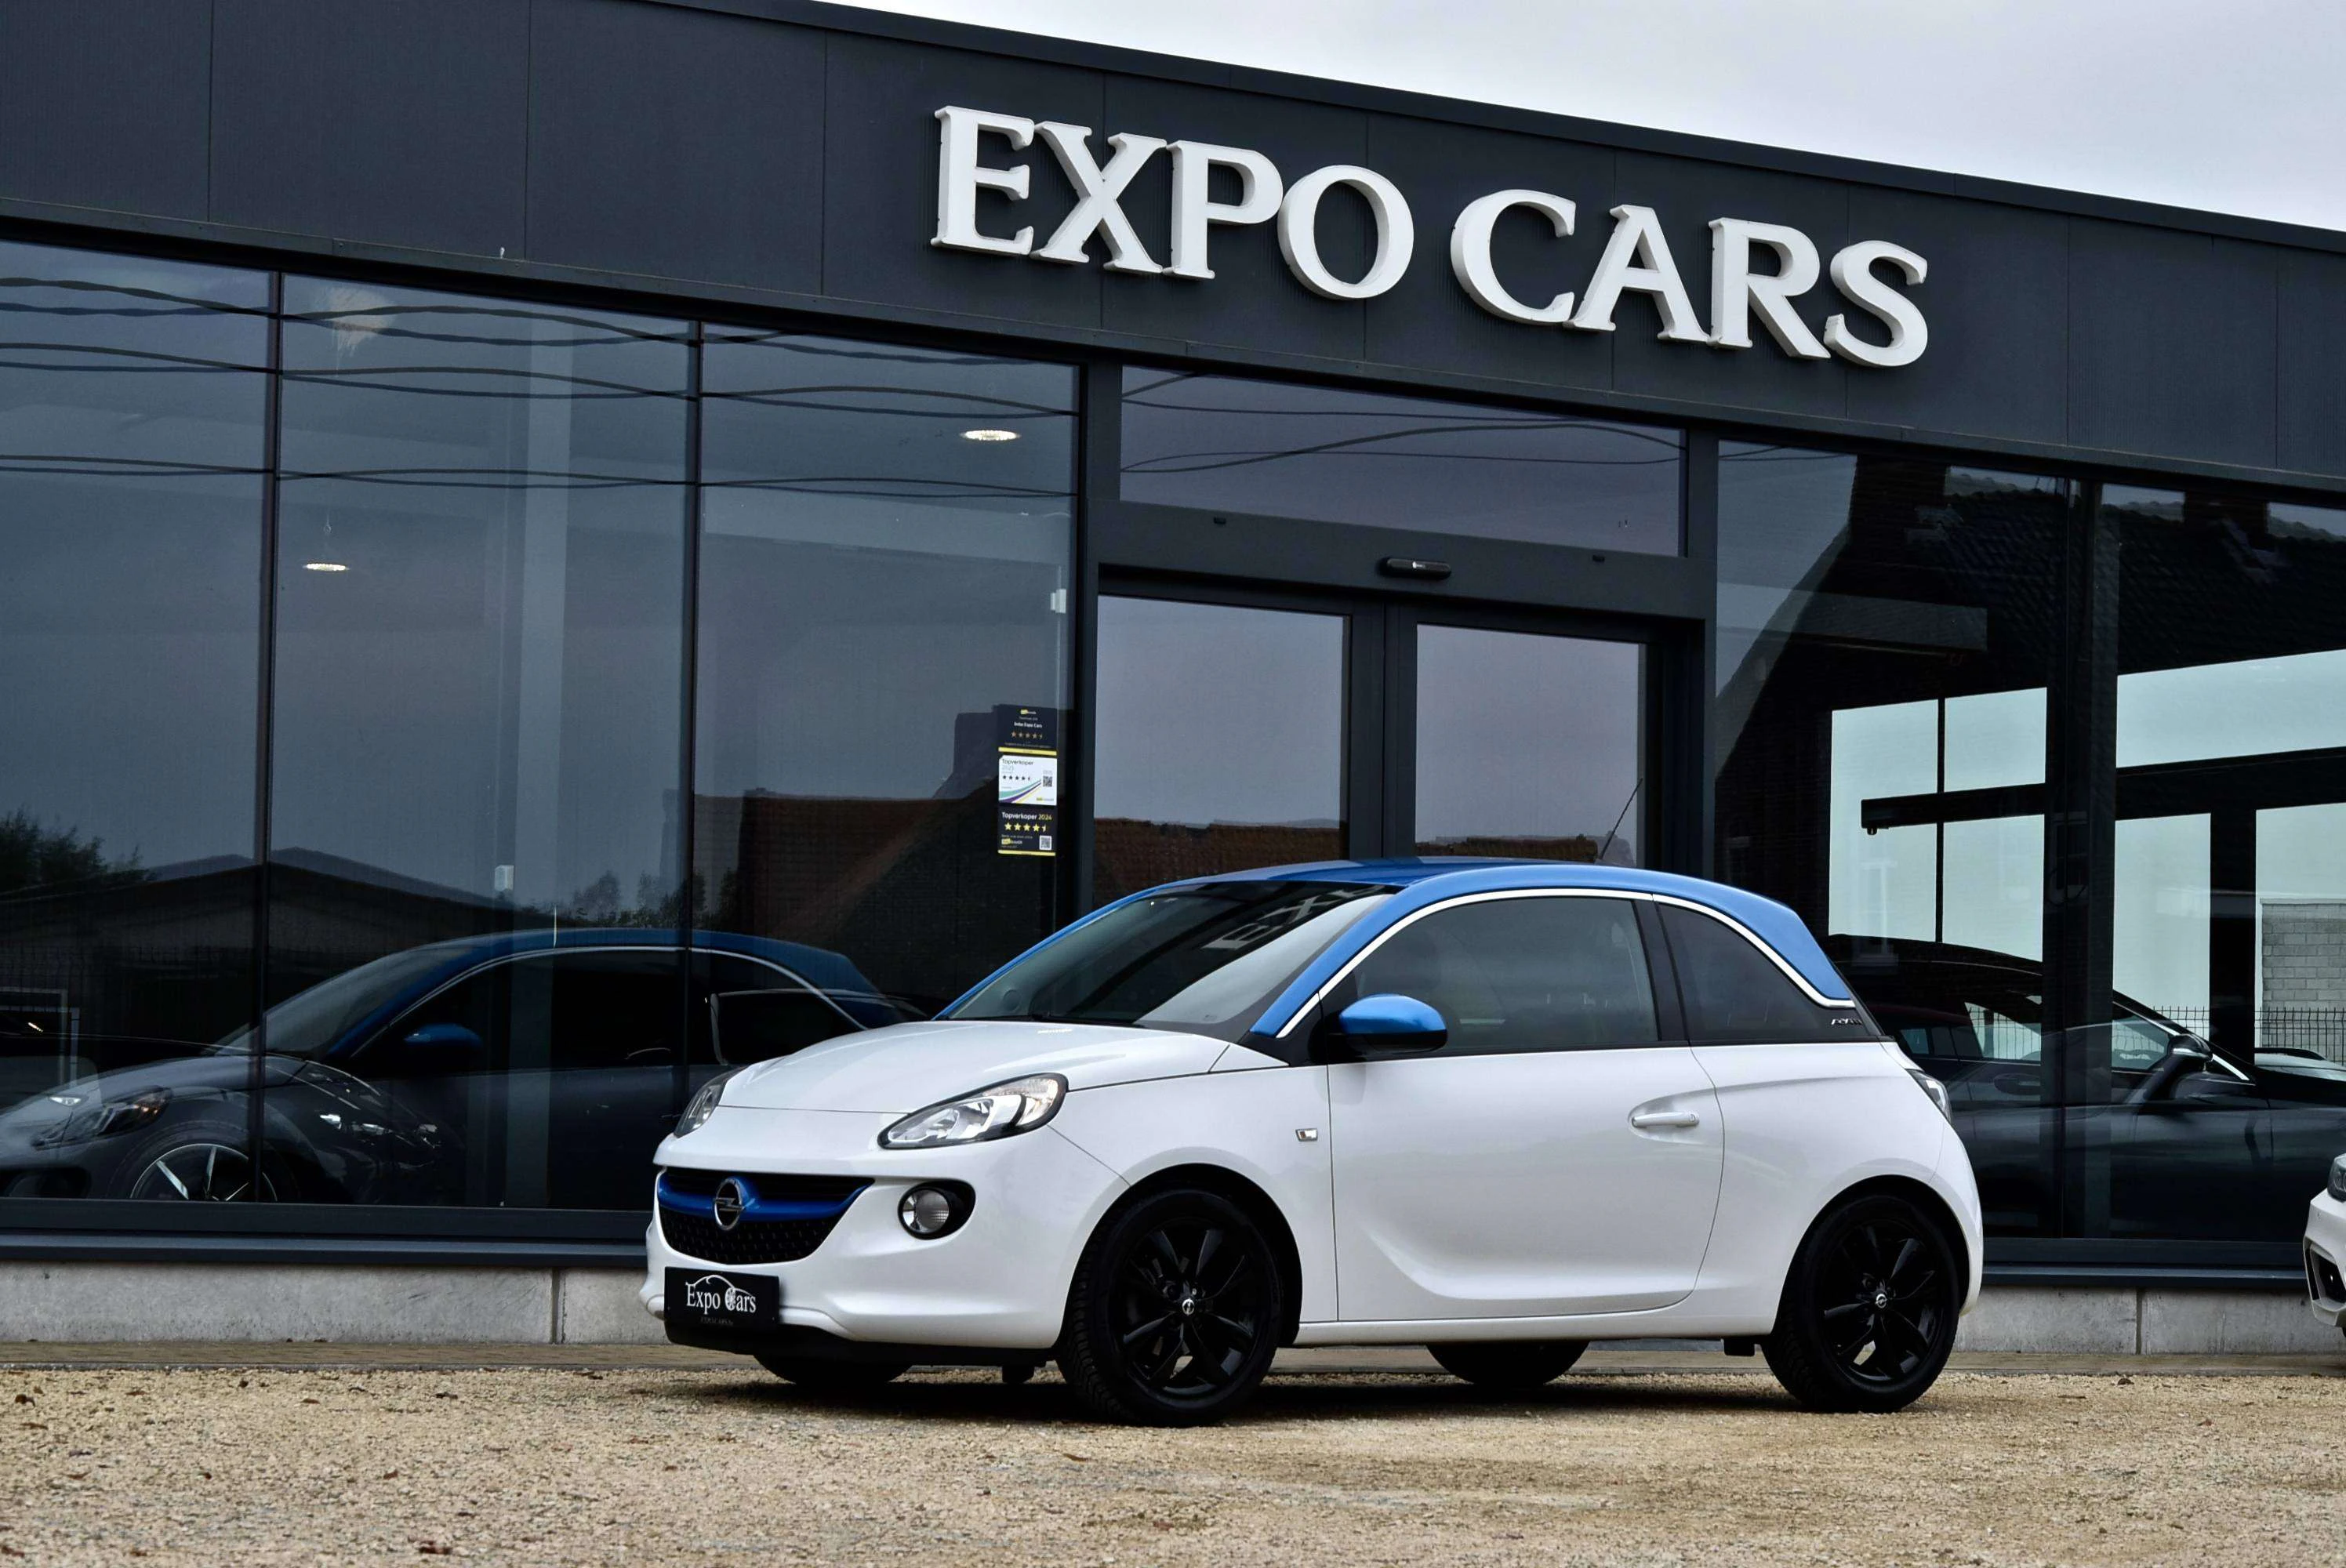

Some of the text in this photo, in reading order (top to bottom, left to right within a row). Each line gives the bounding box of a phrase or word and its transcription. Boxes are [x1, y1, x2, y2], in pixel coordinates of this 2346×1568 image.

[932, 105, 1929, 368] EXPO CARS
[685, 1280, 757, 1315] Expo Cars
